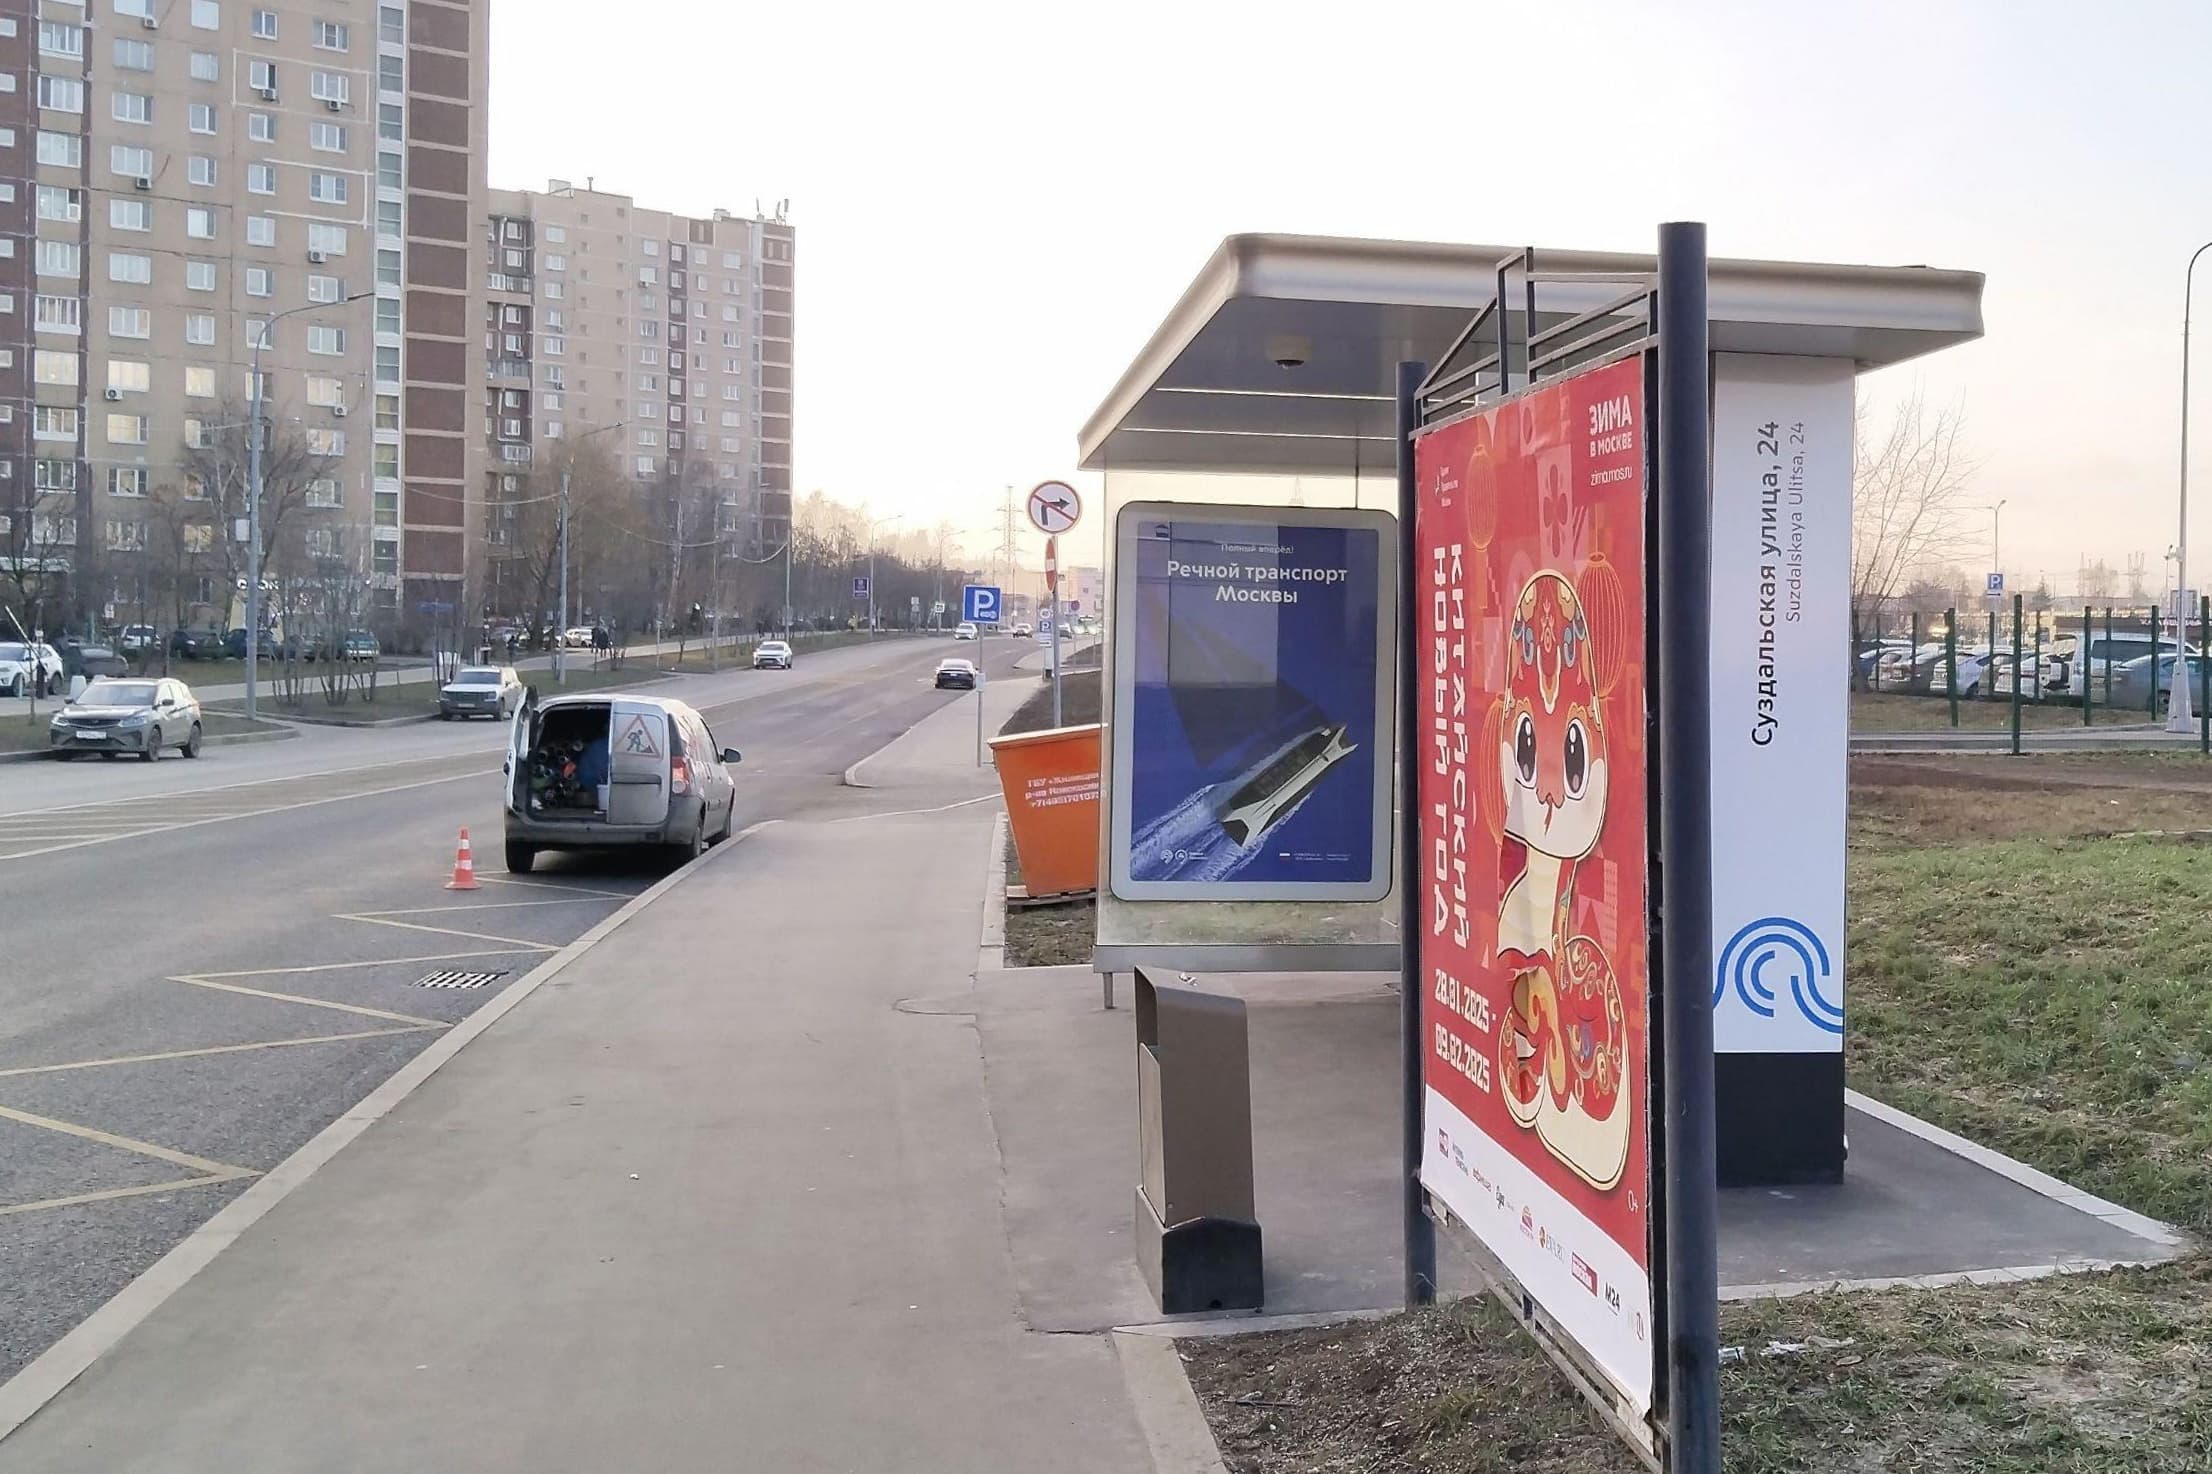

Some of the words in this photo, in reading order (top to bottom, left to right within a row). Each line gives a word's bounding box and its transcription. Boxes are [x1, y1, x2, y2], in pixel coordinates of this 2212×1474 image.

[1589, 395, 1632, 435] ЗИМА
[1590, 441, 1597, 457] В
[1598, 431, 1632, 455] МОСКВЕ
[1757, 421, 1779, 456] 24
[1789, 421, 1804, 445] 24
[1788, 451, 1807, 505] Ulitsa,
[1761, 464, 1783, 557] улица,
[1167, 560, 1240, 579] Речной
[1245, 565, 1348, 584] транспорт
[1215, 585, 1298, 604] Москвы
[1786, 512, 1806, 622] Suzdalskaya
[1434, 547, 1450, 776] НОВЫЙ
[1752, 566, 1778, 745] Суздальская
[1451, 543, 1470, 950] КИТАЙСКИЙ
[1433, 802, 1448, 937] ГОД
[1435, 968, 1490, 1034] 28.01.2025
[1435, 1022, 1491, 1095] 09.02.2025
[1605, 1281, 1621, 1311] M24
